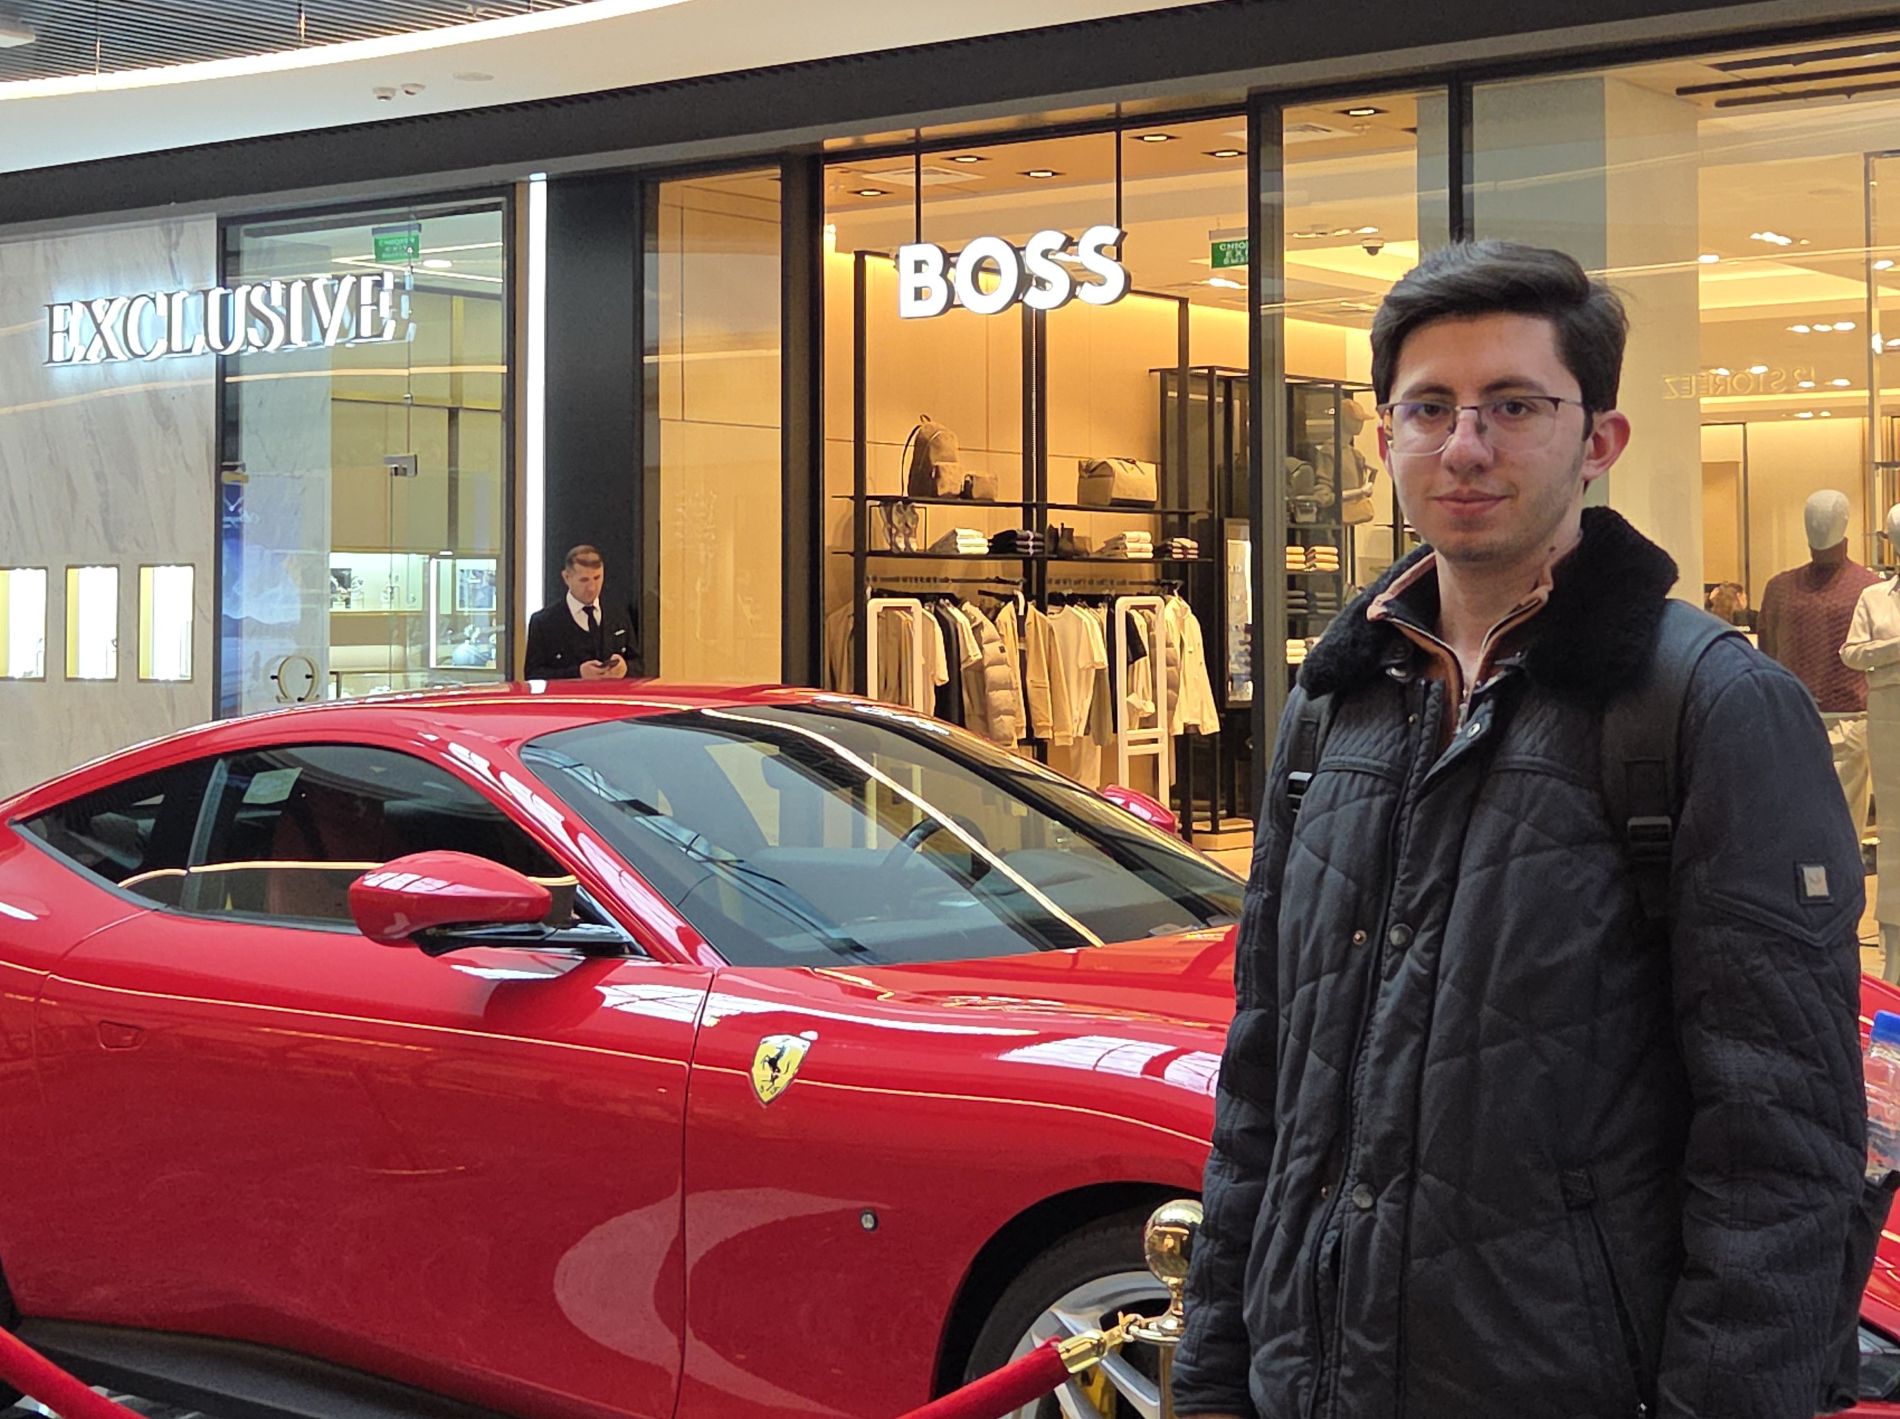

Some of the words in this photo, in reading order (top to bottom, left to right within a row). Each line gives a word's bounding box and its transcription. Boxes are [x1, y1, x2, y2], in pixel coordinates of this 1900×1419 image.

[898, 224, 1132, 319] BOSS
[1219, 241, 1248, 251] CHIQ
[43, 270, 397, 367] EXCLUSIVE
